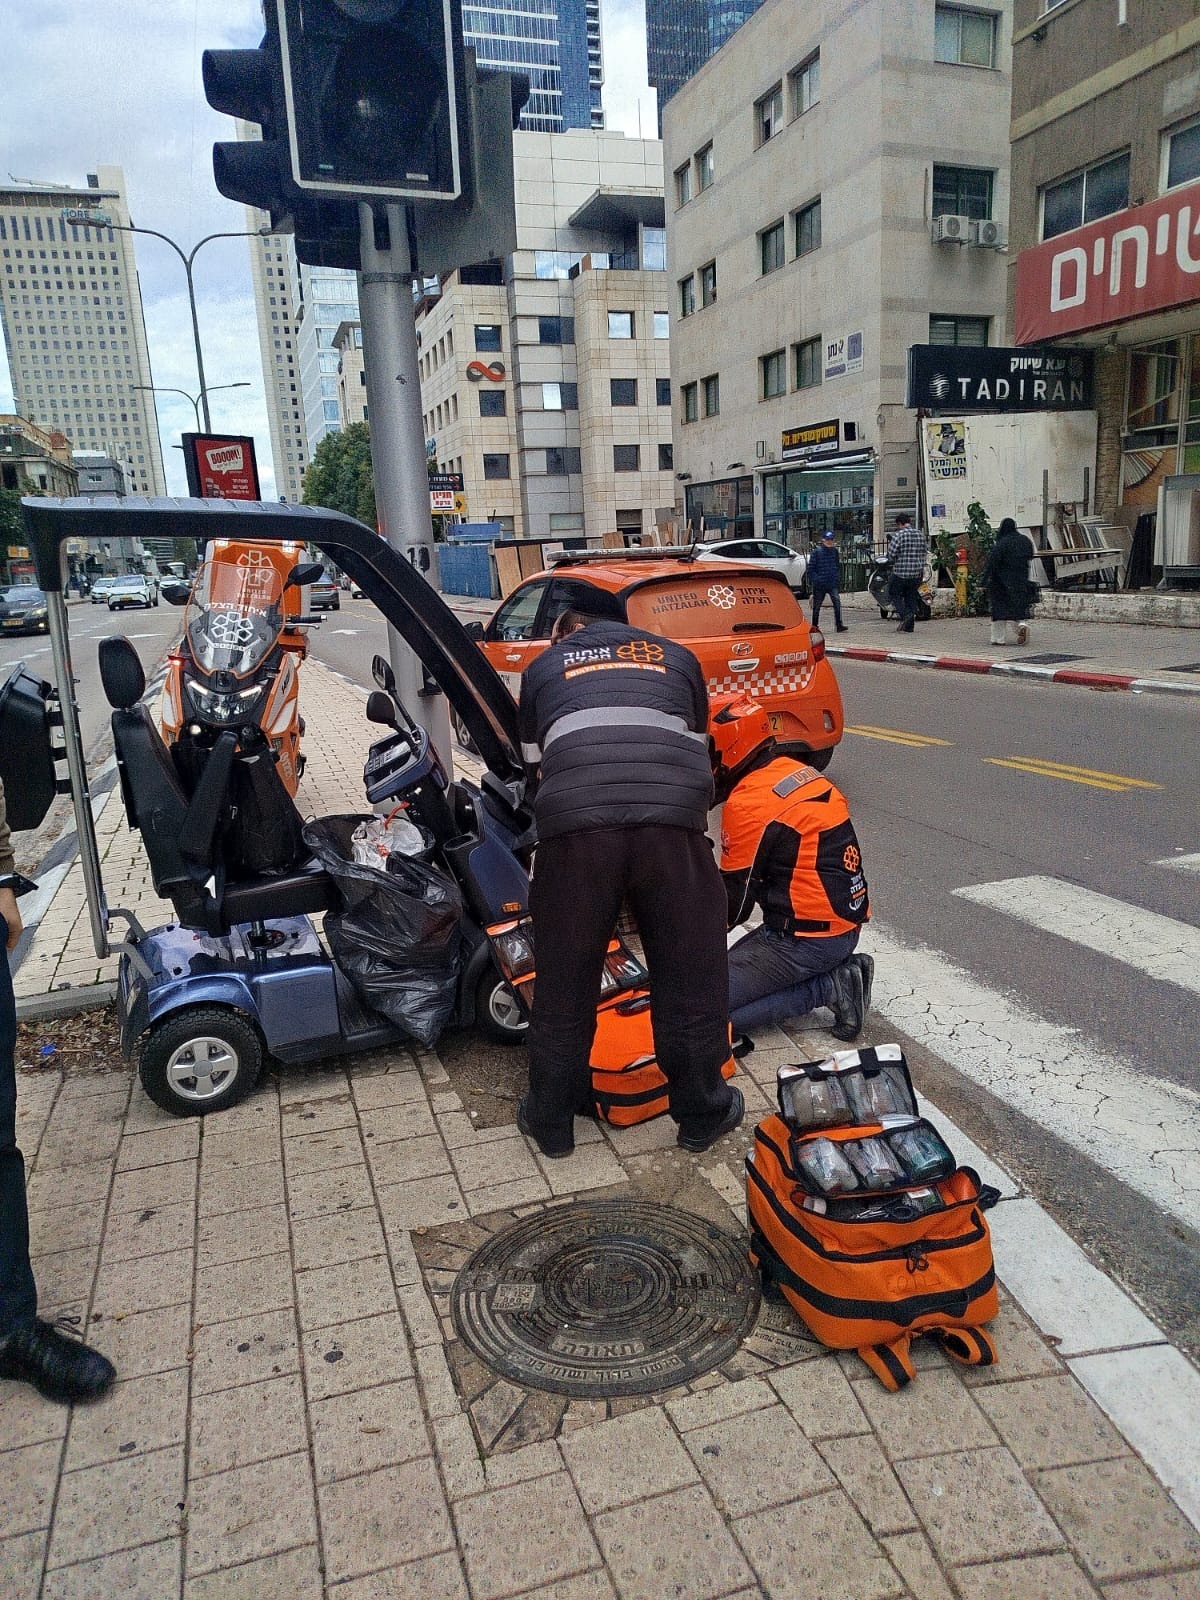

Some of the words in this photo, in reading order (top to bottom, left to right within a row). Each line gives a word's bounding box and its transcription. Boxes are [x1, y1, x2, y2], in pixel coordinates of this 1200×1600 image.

[1010, 356, 1043, 373] שיווק
[957, 377, 1085, 401] TADIRAN
[210, 449, 242, 465] BOOOM!
[657, 592, 698, 605] UNITED
[736, 587, 767, 597] איחוד
[203, 601, 235, 612] הצלה
[651, 599, 709, 615] HATZALAH
[741, 596, 772, 605] הצלה
[237, 603, 268, 618] איחוד
[563, 647, 611, 660] איחוד
[563, 1341, 634, 1357] תאורה
